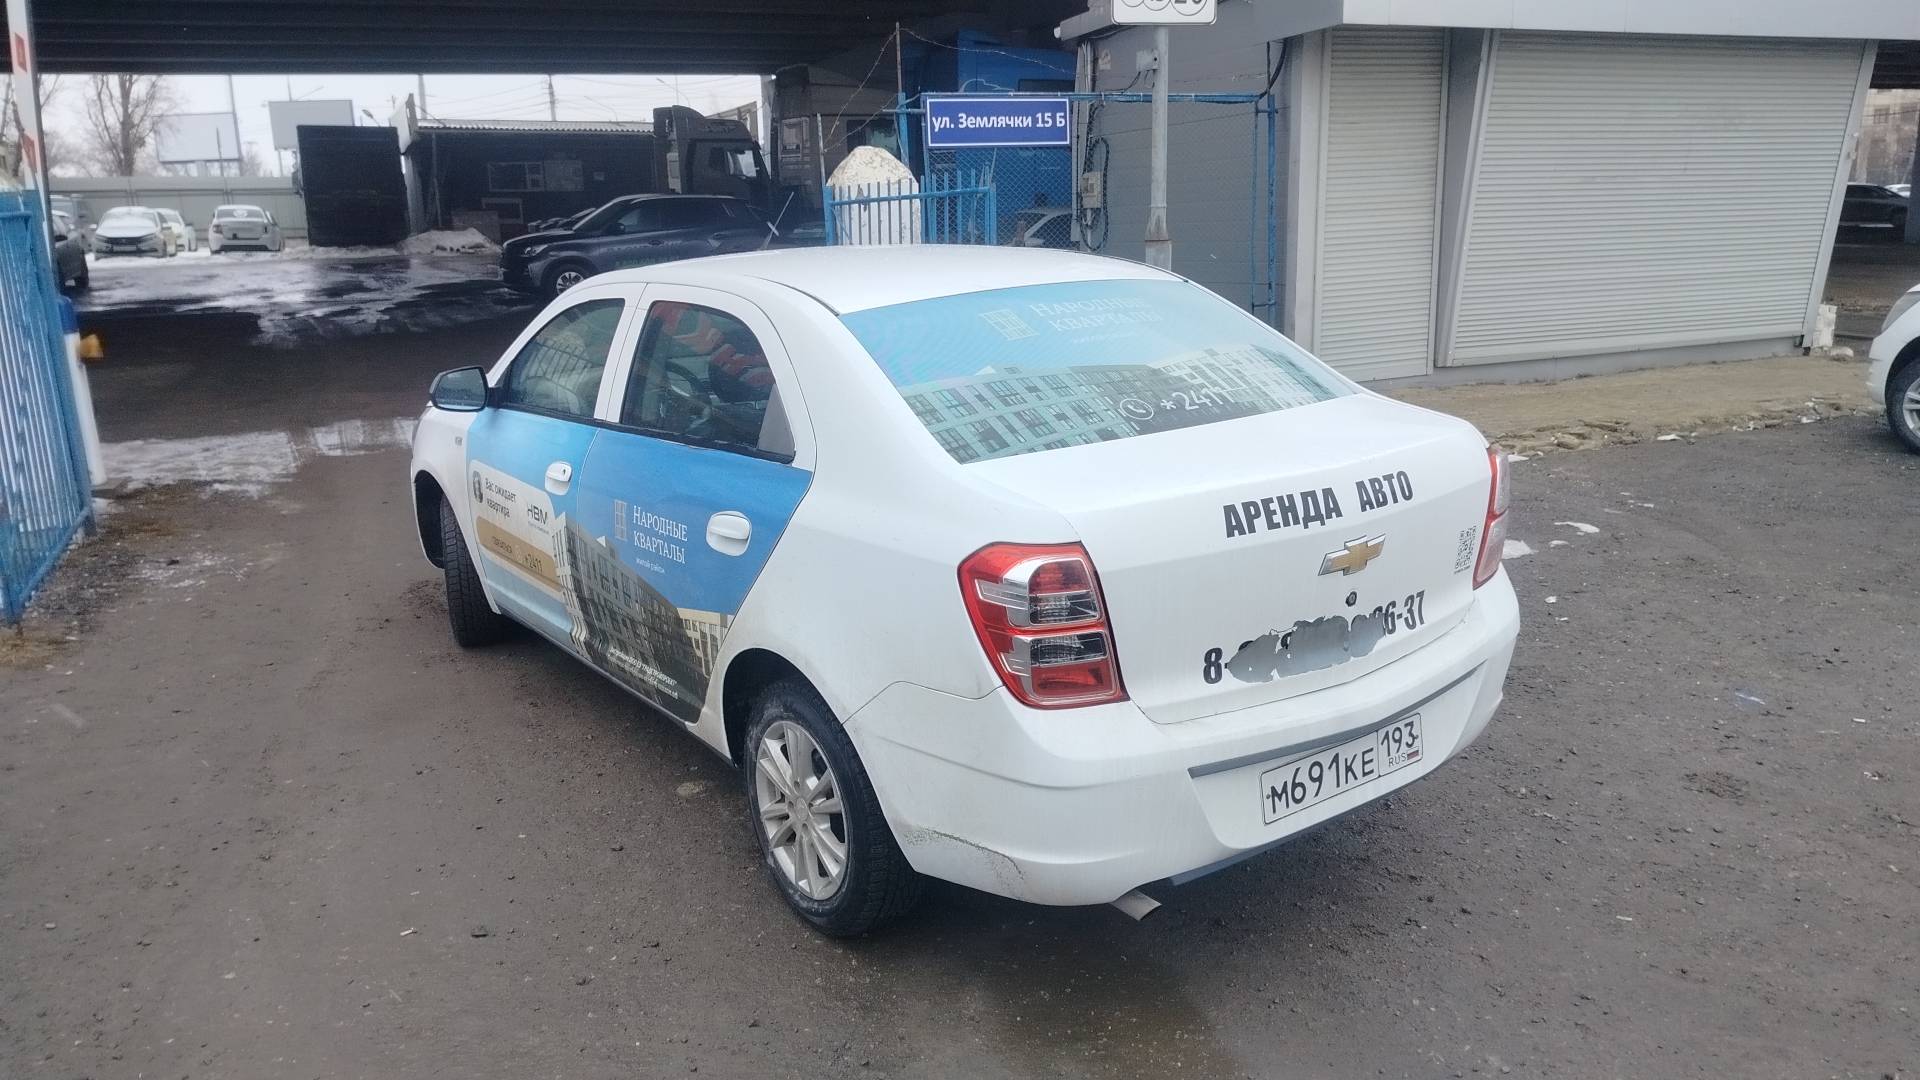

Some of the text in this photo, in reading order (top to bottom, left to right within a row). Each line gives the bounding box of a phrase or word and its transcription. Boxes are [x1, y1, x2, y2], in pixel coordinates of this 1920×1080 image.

[932, 111, 1066, 132] ул. Землячки 15 Б
[1223, 470, 1414, 538] АРЕНДА АВТО
[633, 530, 686, 564] КВАРТАЛЫ
[1381, 721, 1416, 757] 193
[1388, 752, 1407, 767] RUS
